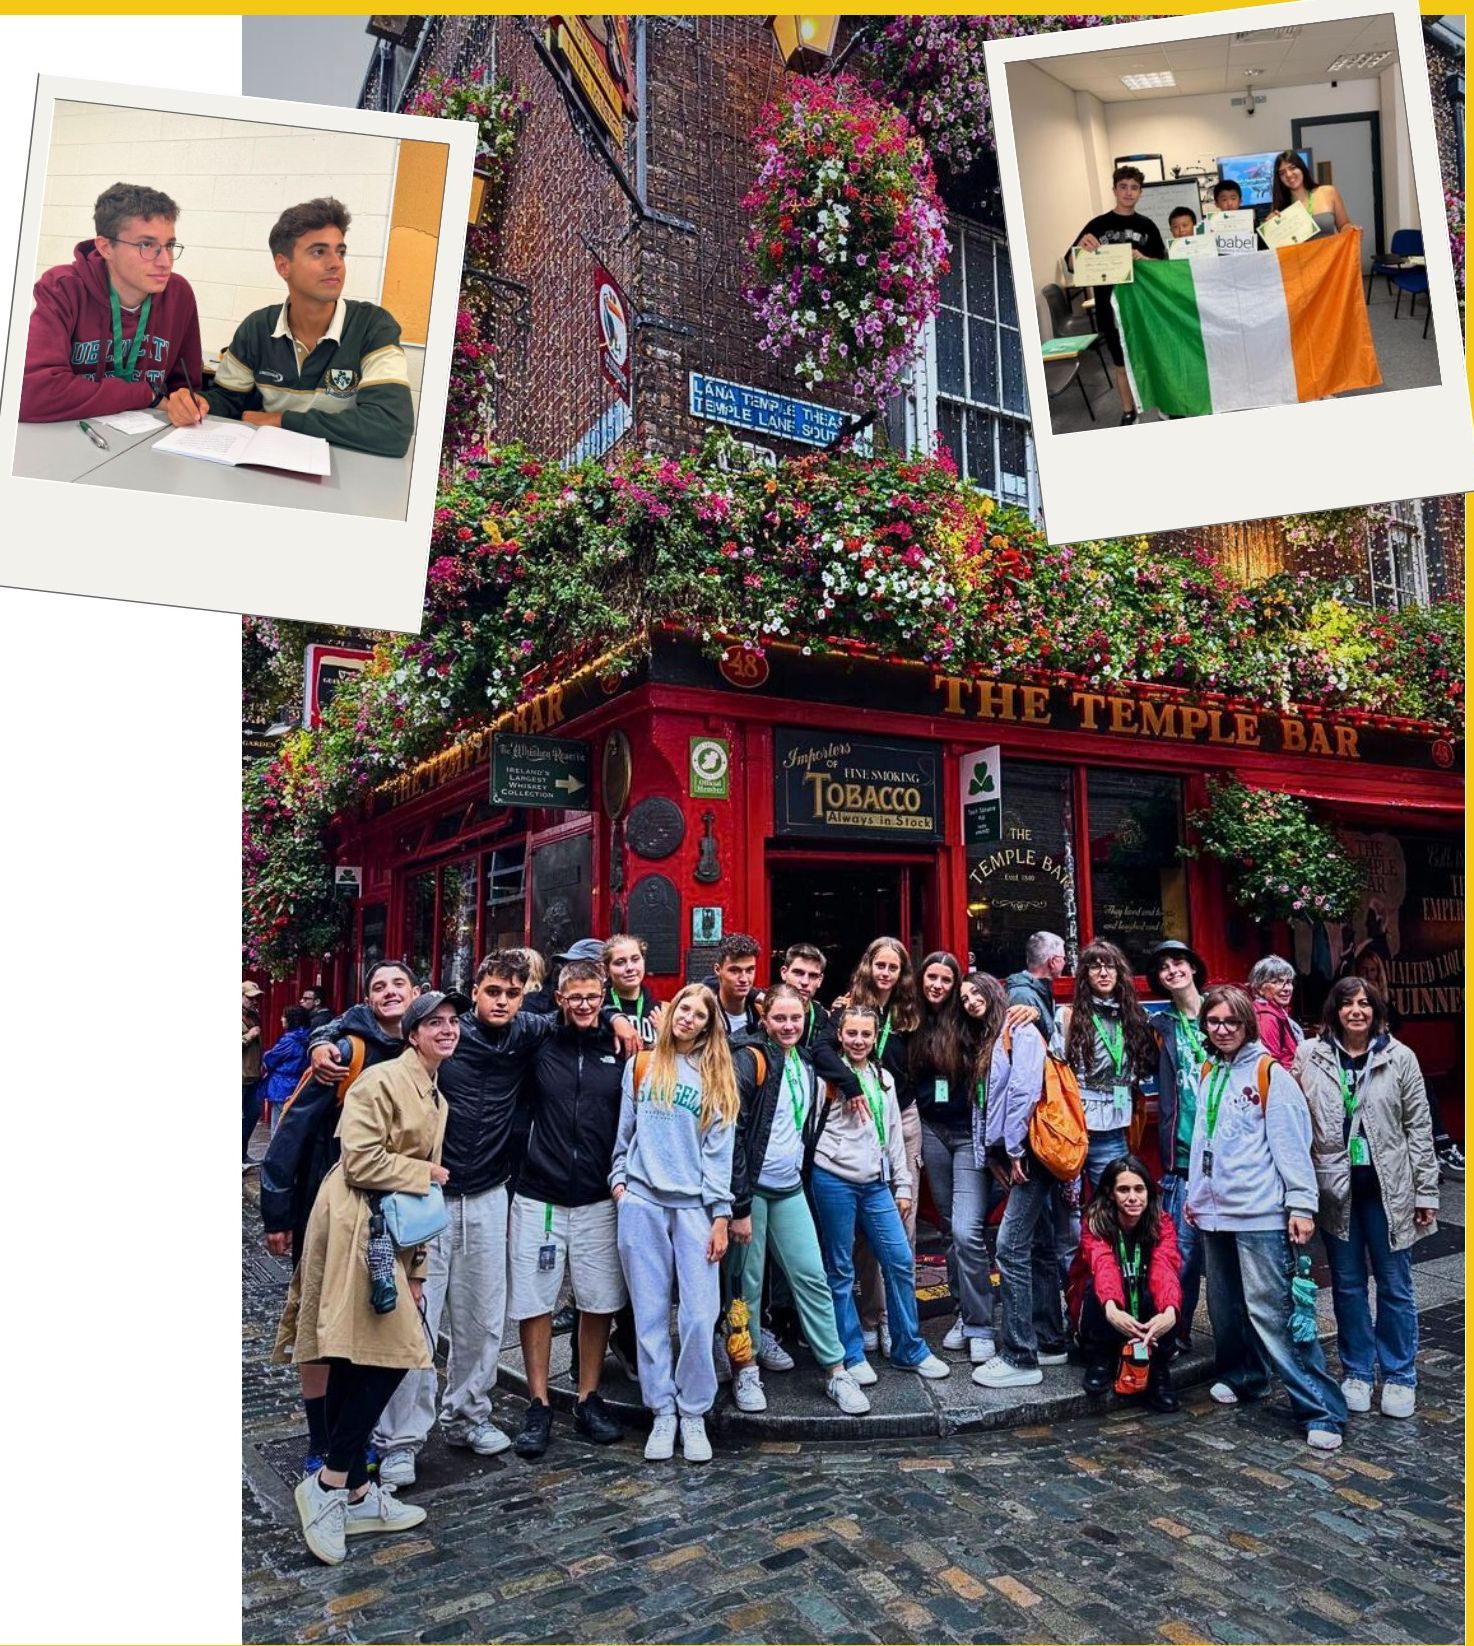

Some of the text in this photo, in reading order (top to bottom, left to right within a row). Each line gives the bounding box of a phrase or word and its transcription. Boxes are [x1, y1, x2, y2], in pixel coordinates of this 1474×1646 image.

[742, 391, 796, 417] TEMPLE
[694, 396, 839, 442] TEMPLE LANE SOUT
[728, 650, 758, 678] 48
[935, 674, 1361, 759] THE TEMPLE BAR
[782, 741, 852, 771] Importers
[826, 759, 839, 768] OF
[508, 774, 547, 783] LARGEST
[508, 781, 548, 790] WHISKEY
[844, 767, 921, 784] FINE SMOKING
[501, 788, 554, 798] COLLECTION
[803, 771, 921, 818] TOBACCO
[827, 811, 931, 828] Always in Stock
[1010, 827, 1033, 841] THE
[969, 848, 1036, 885] TEMPLE
